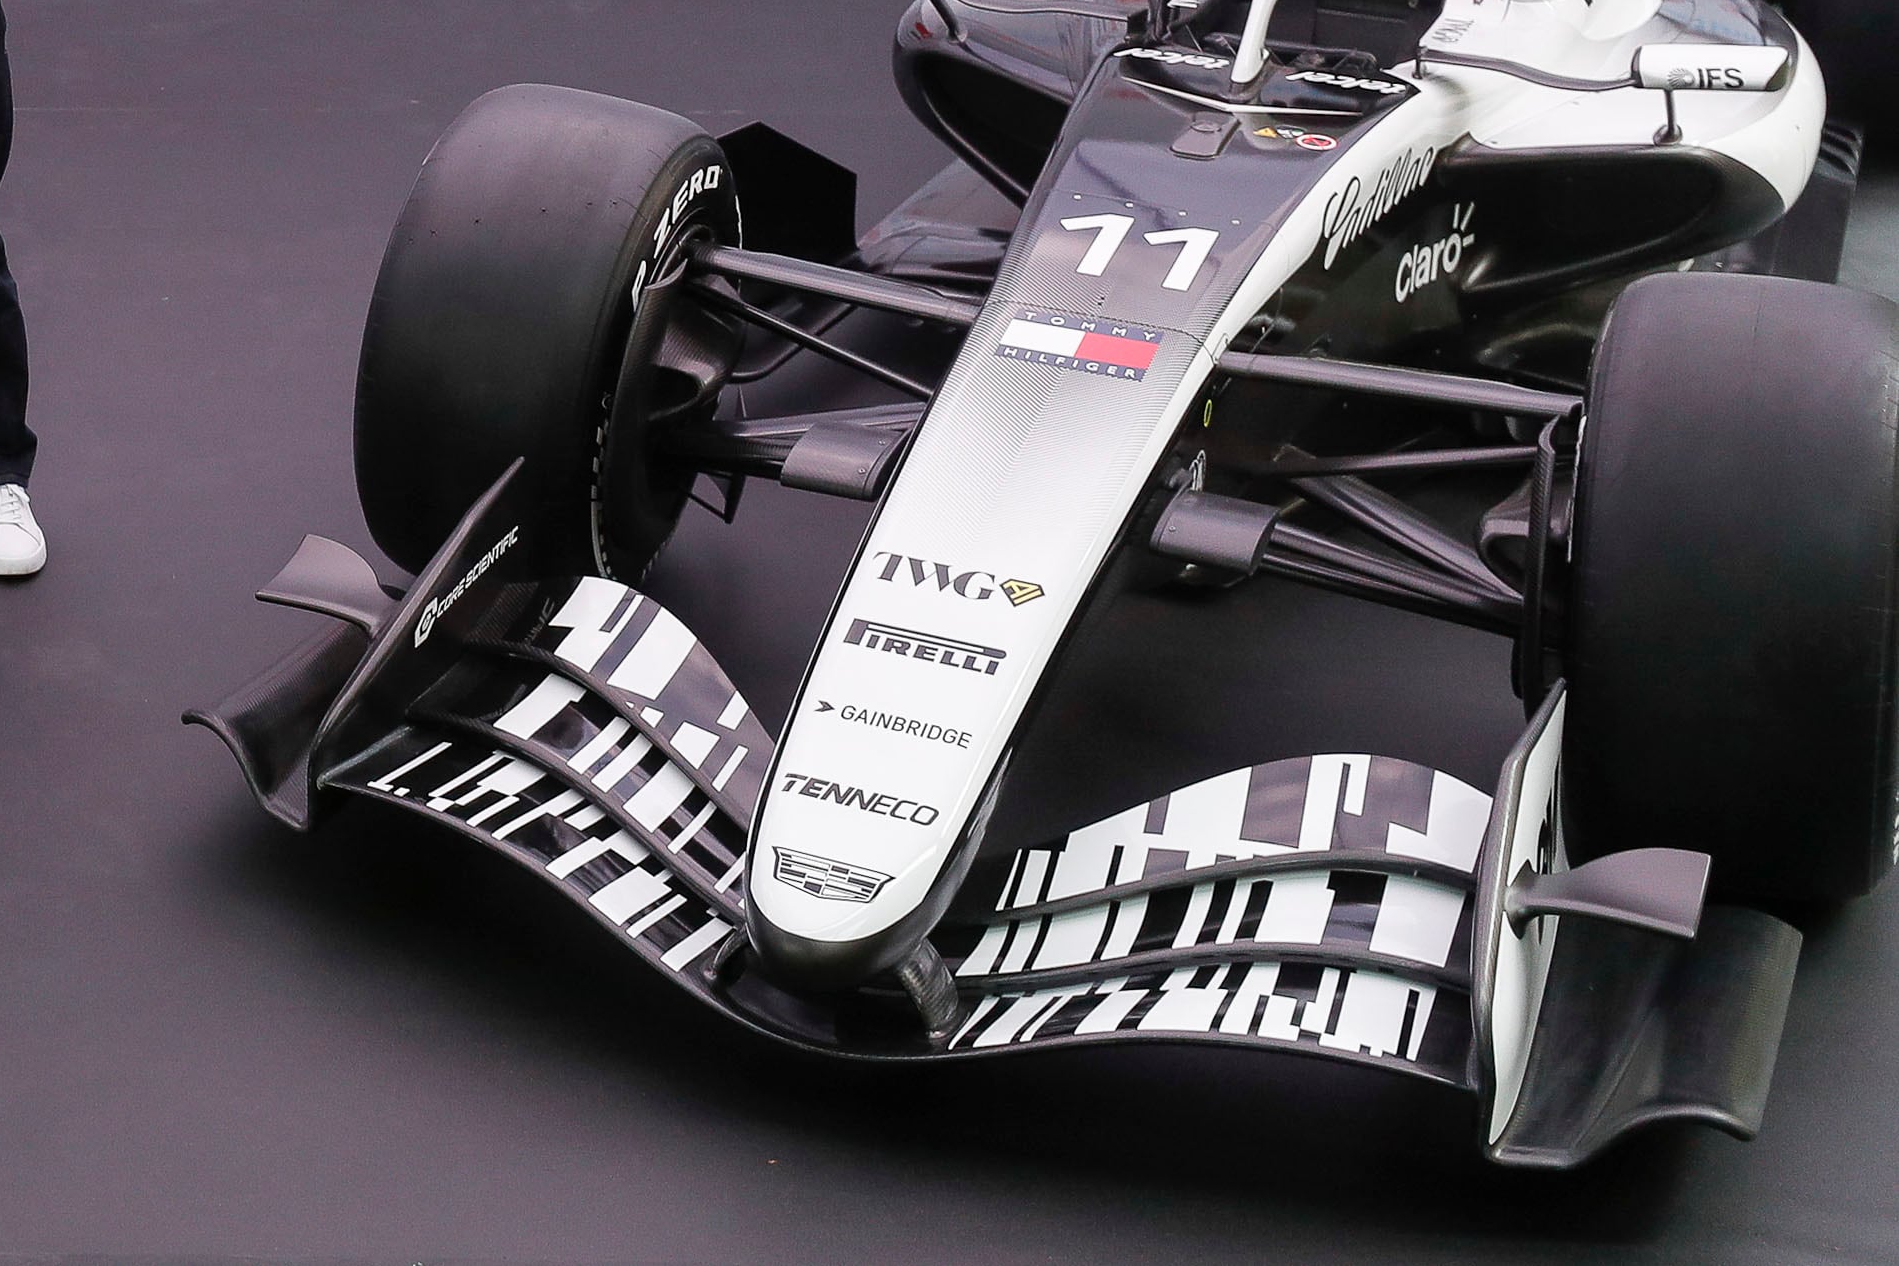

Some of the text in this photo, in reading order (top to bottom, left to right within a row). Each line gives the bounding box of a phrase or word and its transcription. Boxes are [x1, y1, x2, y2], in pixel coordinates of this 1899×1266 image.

[652, 164, 722, 260] ZERO
[1059, 212, 1220, 293] 11
[1394, 229, 1465, 304] Claro
[1021, 310, 1157, 342] TOMMY
[1001, 346, 1147, 382] HILFIGER
[435, 525, 519, 619] CORE SCIENTIFIC
[871, 550, 997, 601] TWG
[842, 617, 1008, 677] PIRELLI
[839, 704, 974, 750] GAINBRIDGE
[780, 771, 940, 826] TENNECO
